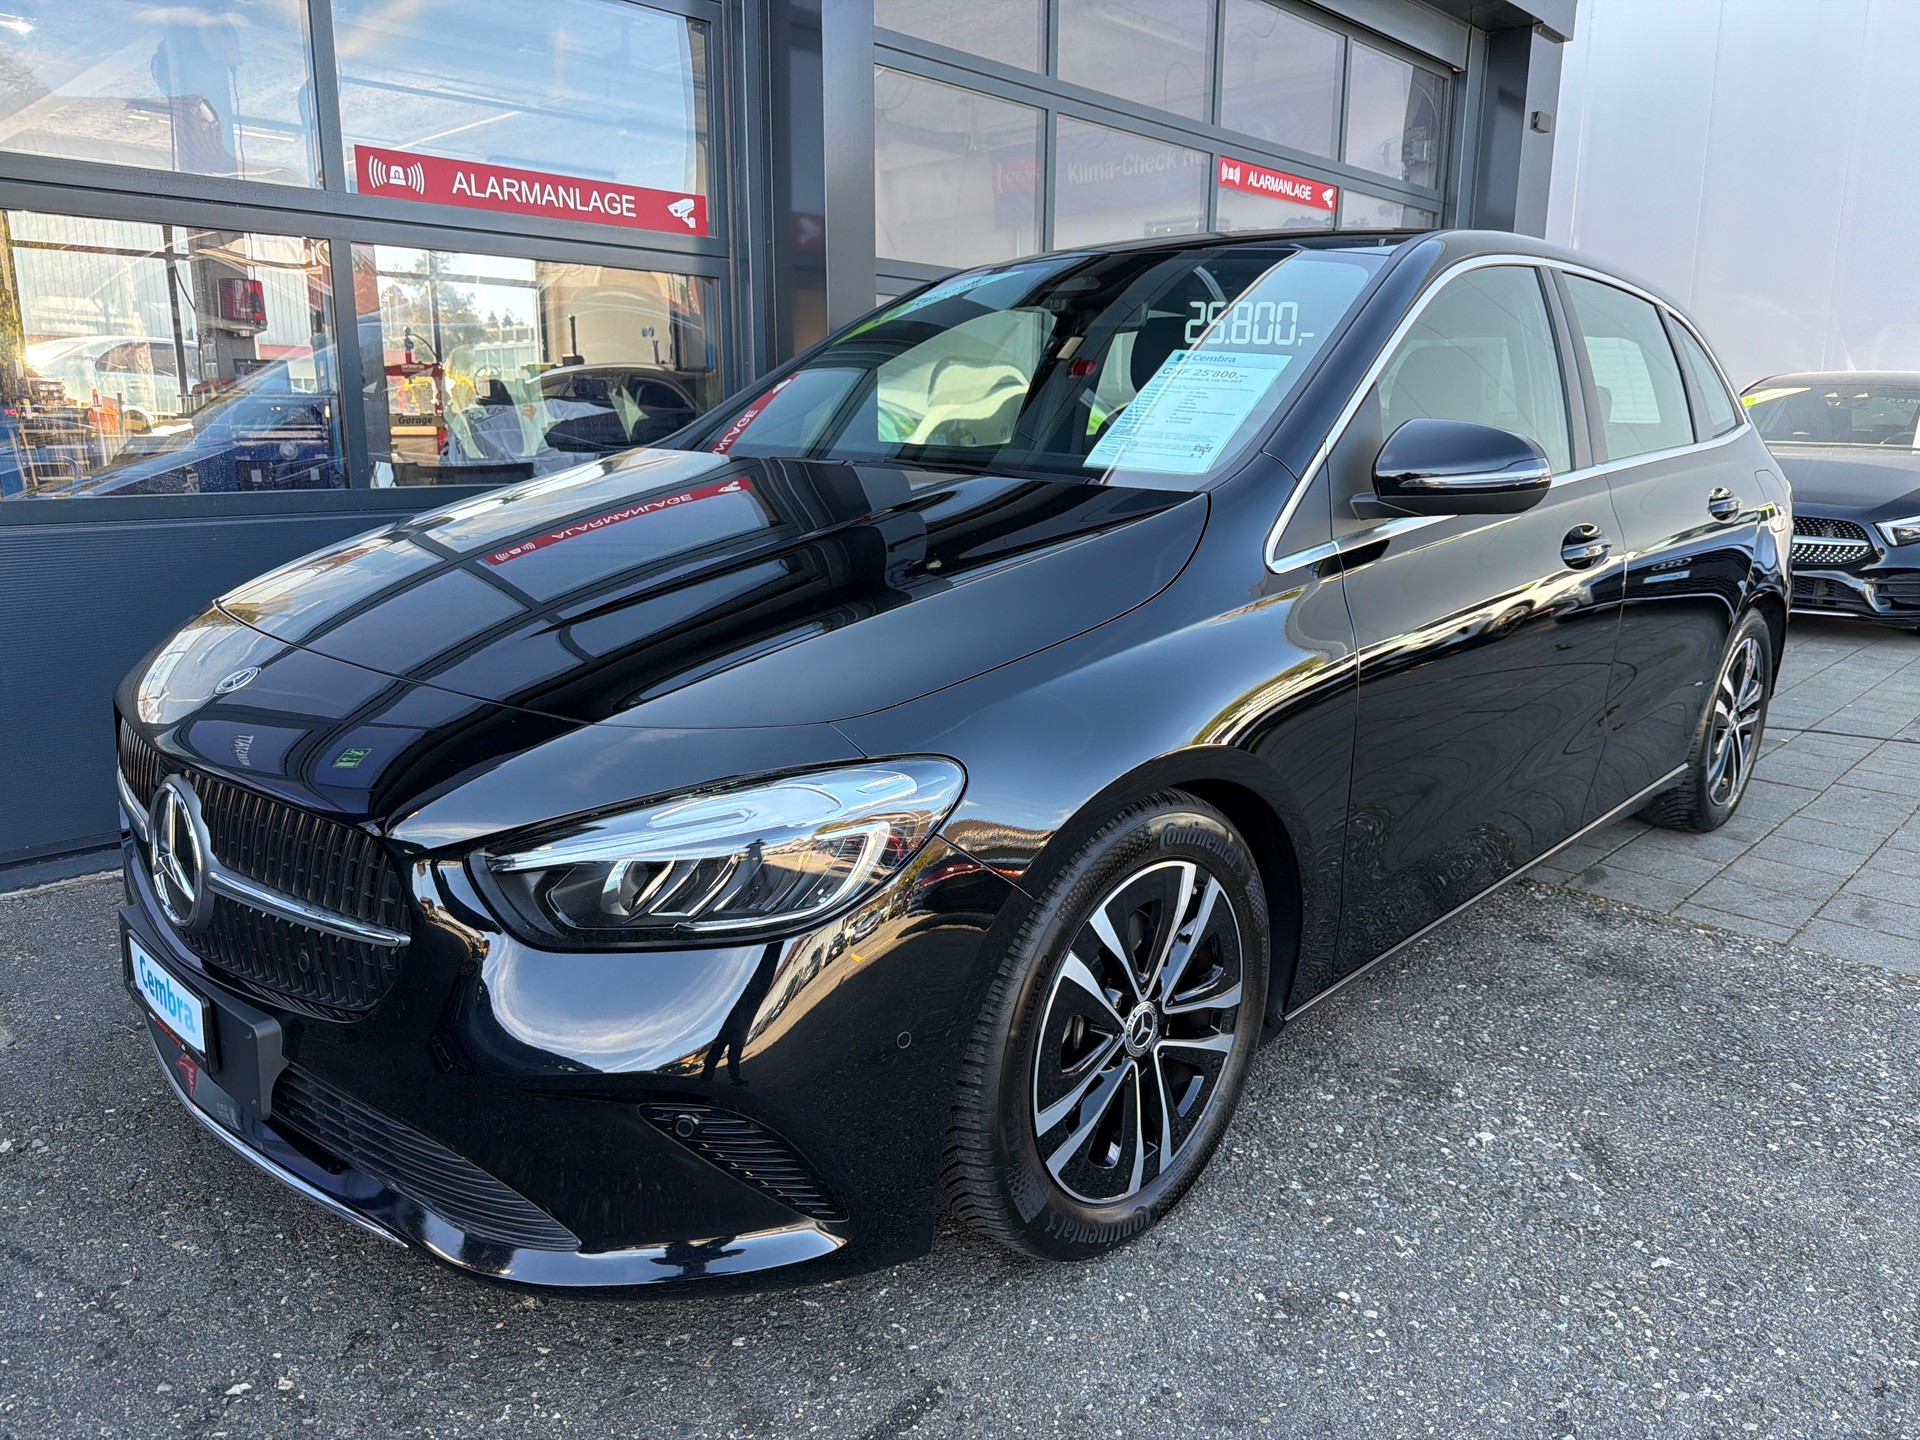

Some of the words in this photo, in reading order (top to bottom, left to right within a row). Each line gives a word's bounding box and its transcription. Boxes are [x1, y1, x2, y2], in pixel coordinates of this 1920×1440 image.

[1067, 149, 1177, 185] Klima-Check
[451, 171, 637, 218] ALARMANLAGE
[1247, 170, 1312, 201] ALARMANLAGE
[1162, 367, 1191, 376] CHF
[1192, 354, 1237, 363] Cembra
[398, 416, 433, 425] Garage
[1160, 821, 1238, 868] Continental
[139, 955, 197, 1034] Cembra
[1055, 1205, 1149, 1247] Continental
